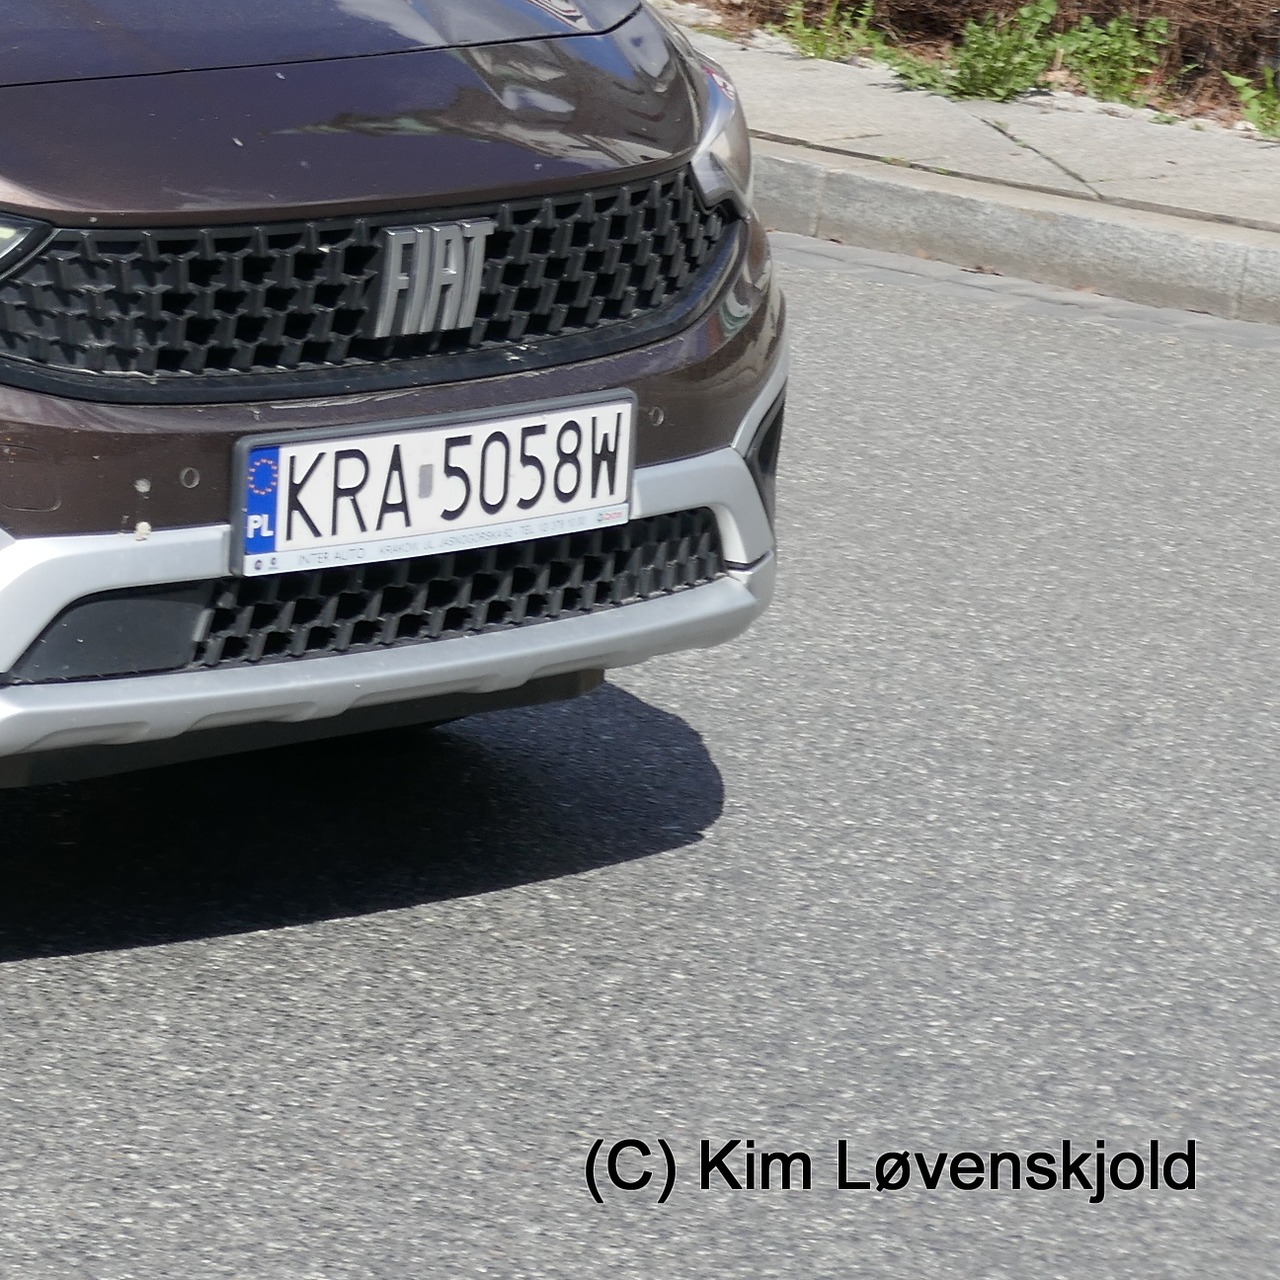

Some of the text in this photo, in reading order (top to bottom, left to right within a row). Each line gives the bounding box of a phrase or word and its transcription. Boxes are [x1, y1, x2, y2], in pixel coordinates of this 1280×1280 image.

[374, 217, 498, 338] FIAT
[246, 513, 275, 539] PL
[285, 411, 623, 542] KRA 5058W
